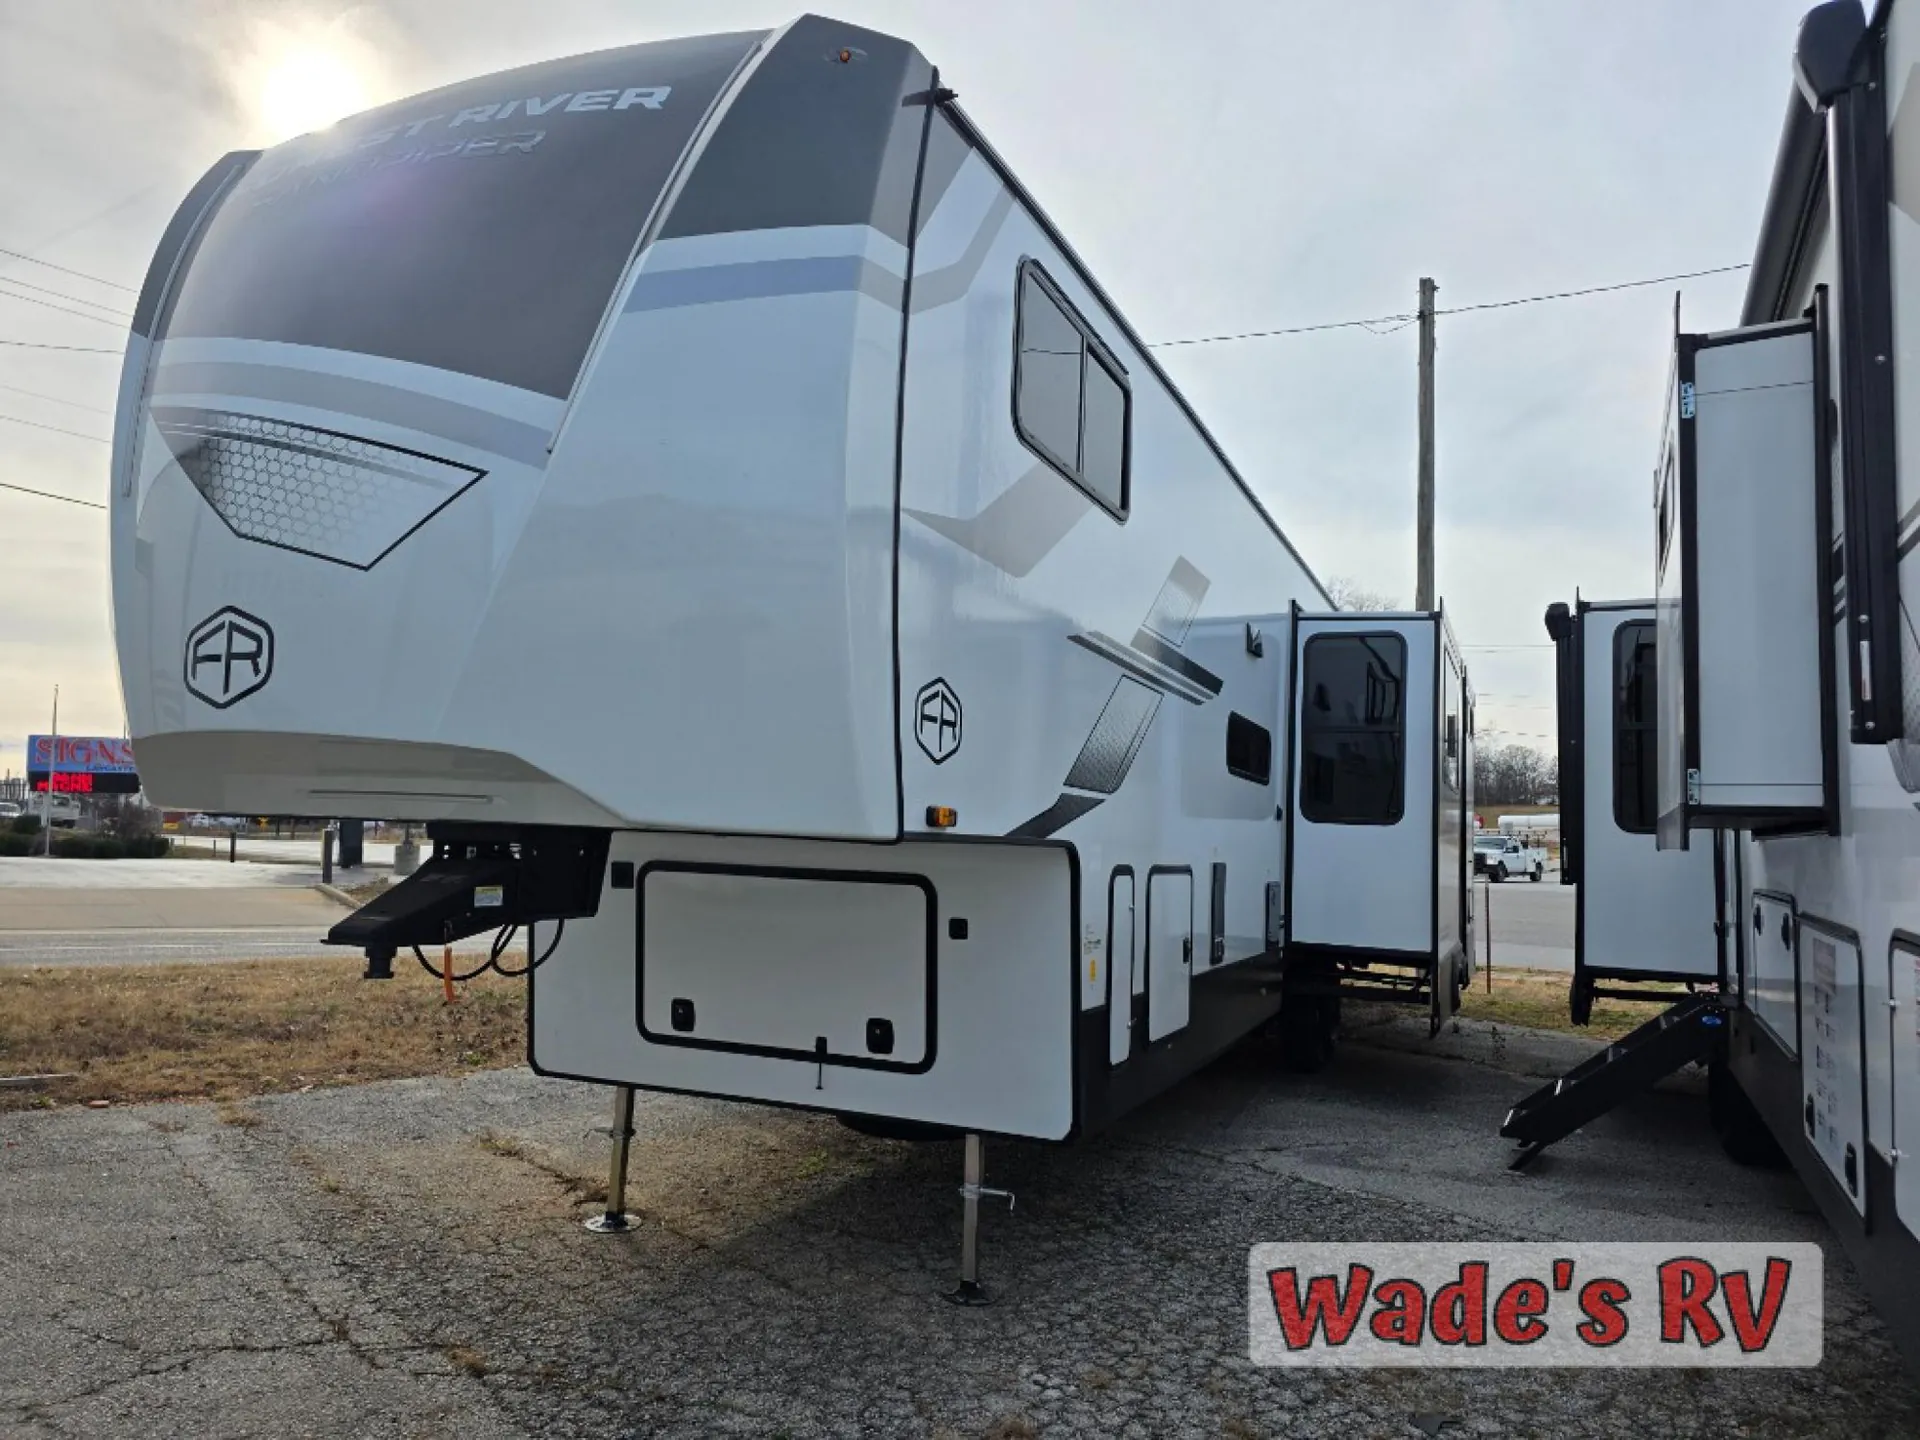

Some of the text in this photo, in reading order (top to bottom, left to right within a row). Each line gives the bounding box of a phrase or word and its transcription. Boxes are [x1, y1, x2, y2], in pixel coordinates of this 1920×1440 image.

[448, 85, 671, 129] RIVER
[252, 130, 546, 206] NPIPER
[35, 736, 136, 765] SIGNS
